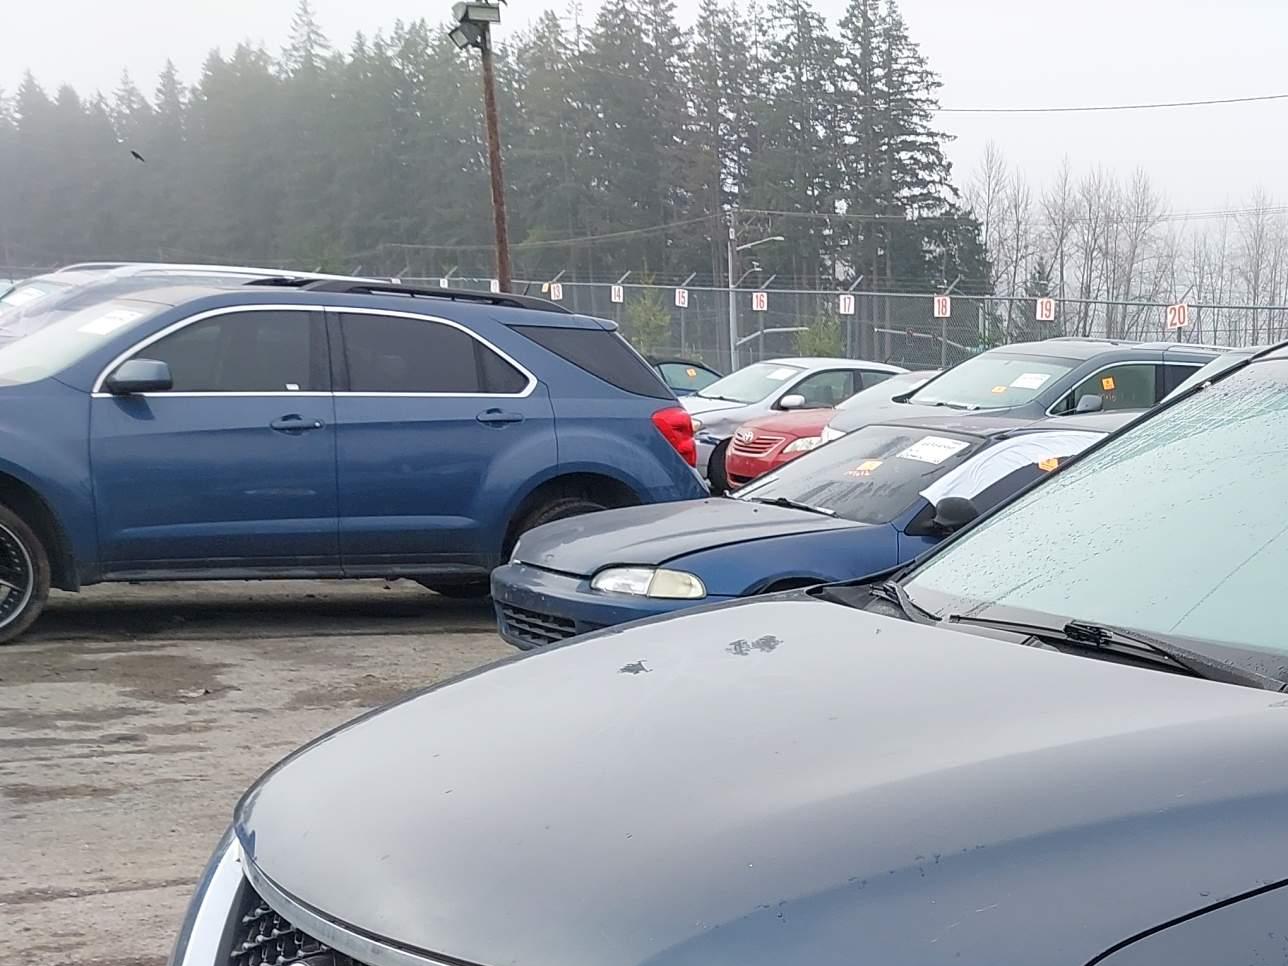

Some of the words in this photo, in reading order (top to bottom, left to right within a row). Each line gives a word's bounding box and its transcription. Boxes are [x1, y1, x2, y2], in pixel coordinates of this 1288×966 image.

[613, 286, 622, 301] 14
[677, 290, 686, 305] 15
[755, 293, 765, 309] 16
[843, 297, 851, 312] 17
[937, 299, 947, 315] 18
[1040, 301, 1051, 318] 19
[1169, 306, 1186, 325] 20
